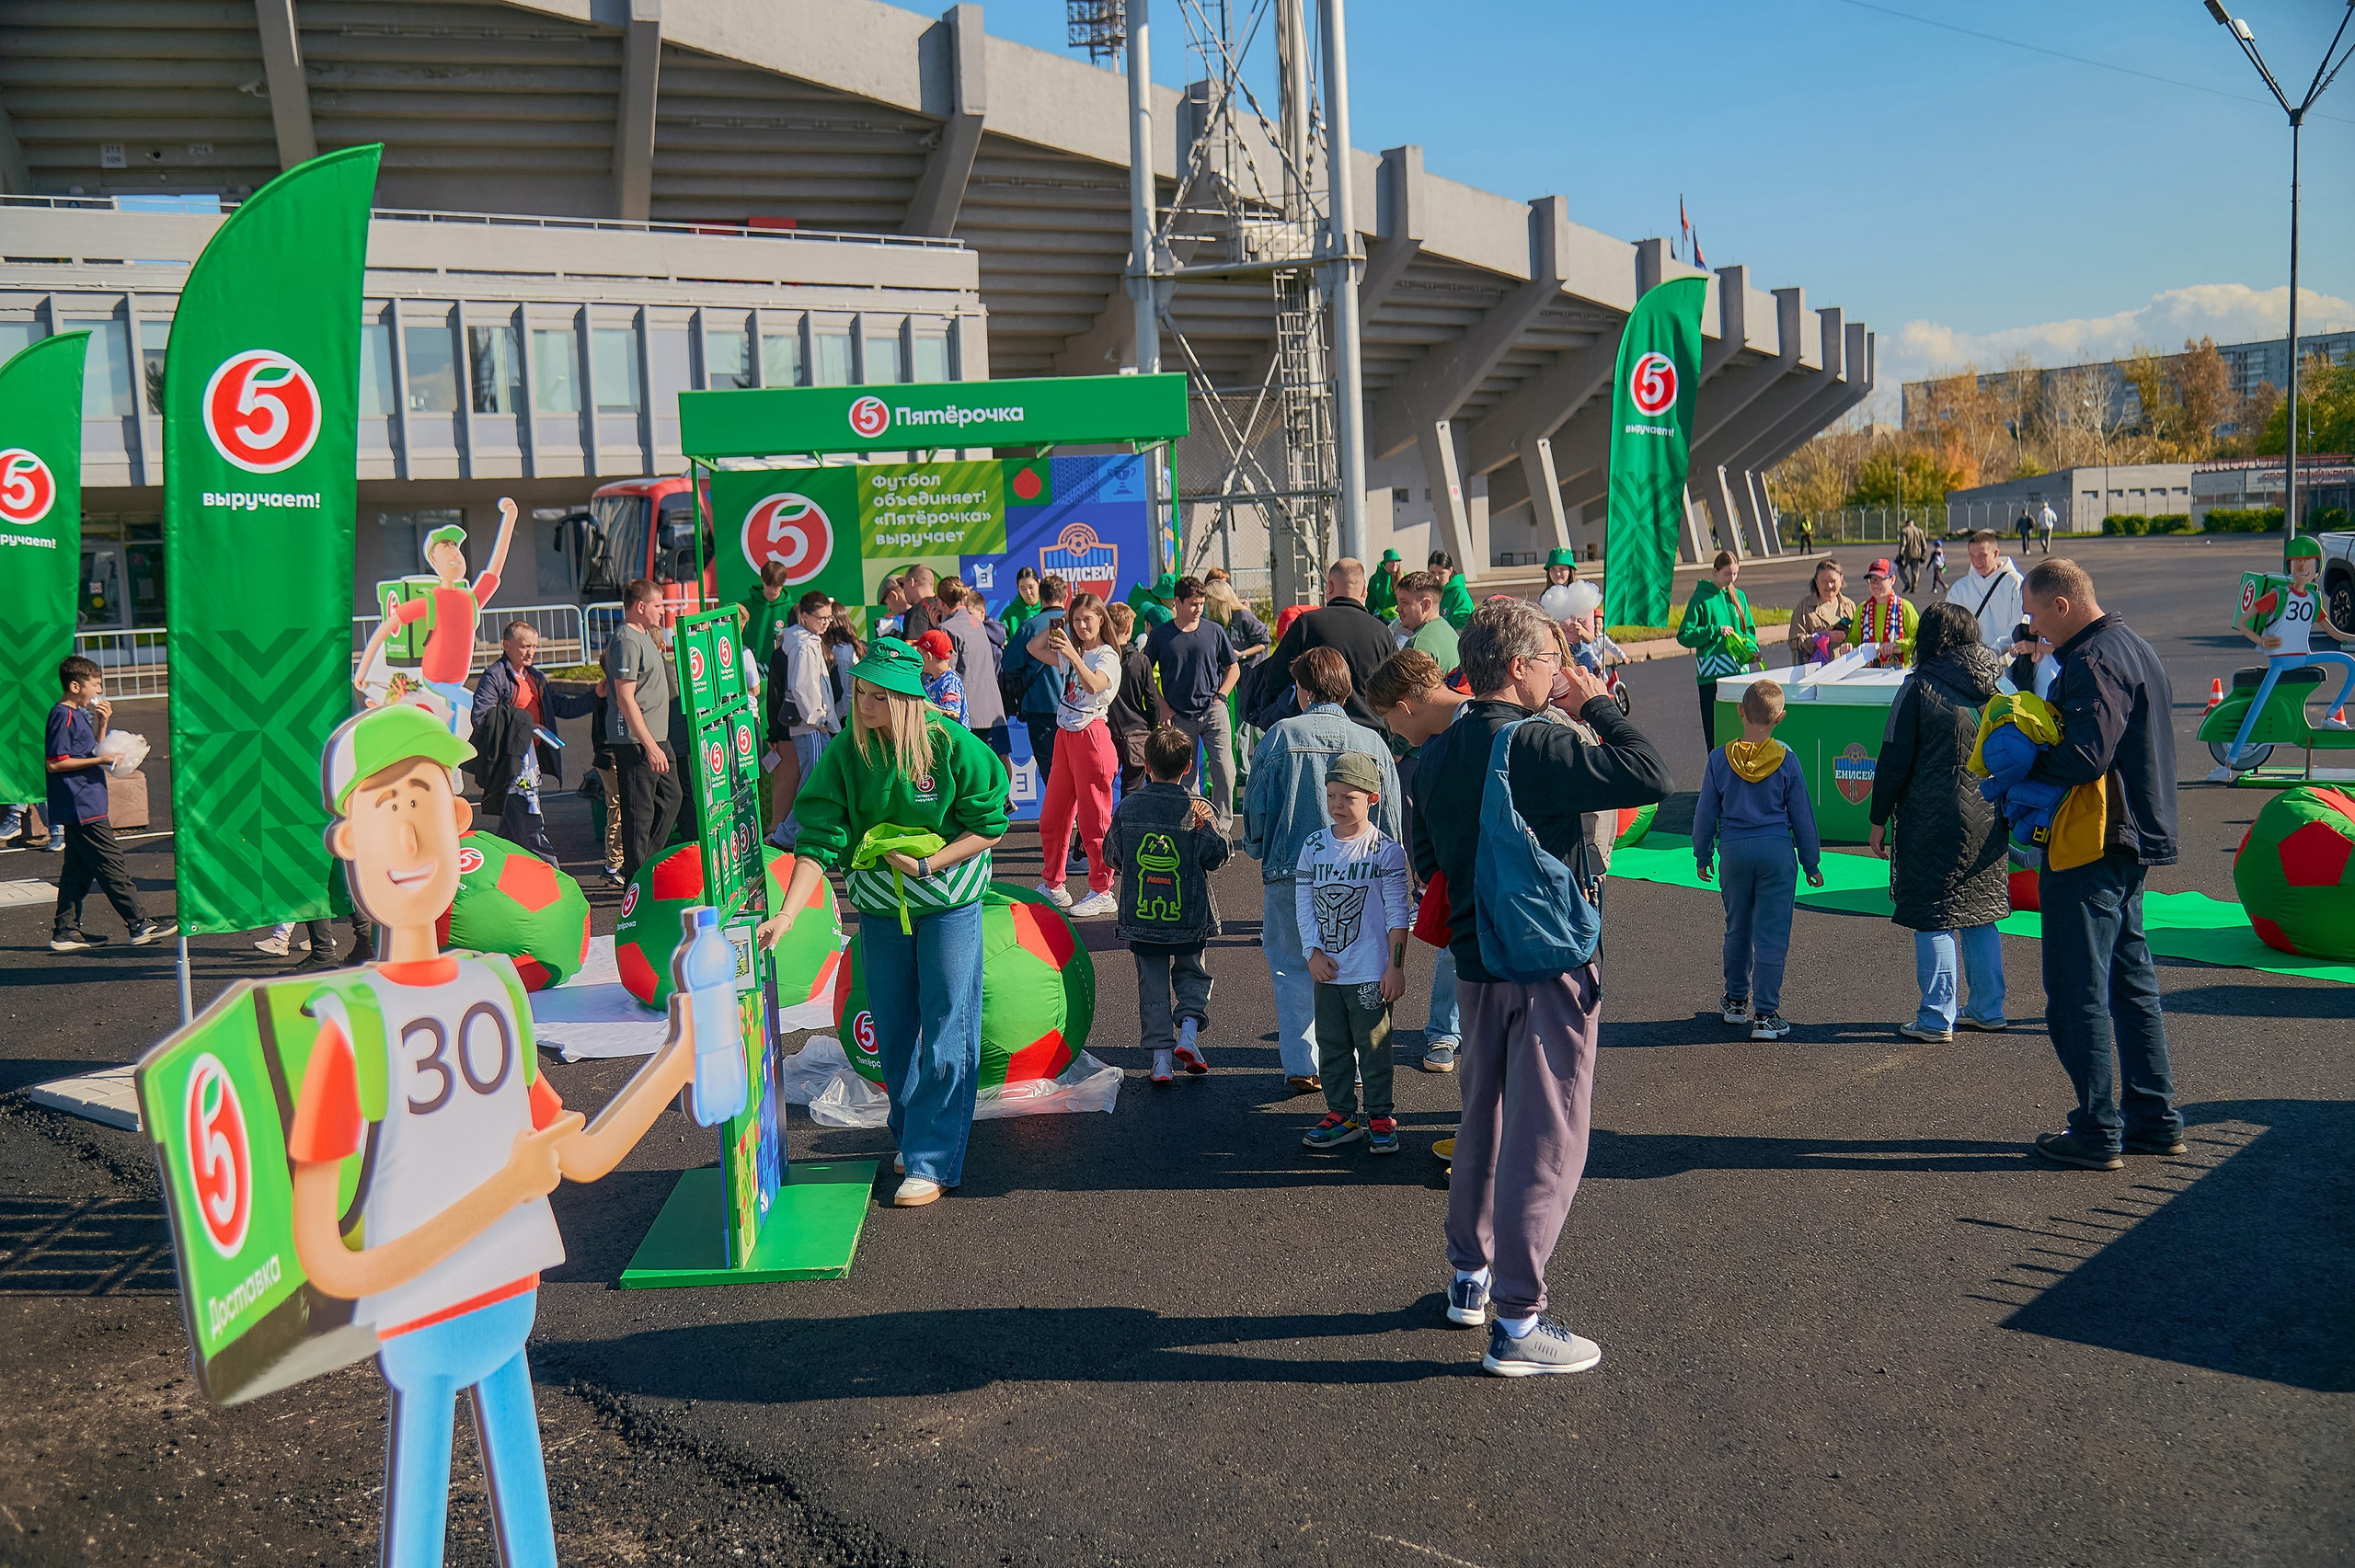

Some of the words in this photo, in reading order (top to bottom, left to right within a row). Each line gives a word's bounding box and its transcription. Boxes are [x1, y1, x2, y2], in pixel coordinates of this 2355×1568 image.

[895, 405, 1025, 429] Пятёрочка
[1625, 423, 1674, 438] выручает!
[872, 473, 941, 491] Футбол
[202, 491, 321, 511] выручает!
[874, 490, 988, 508] объединяет!
[874, 510, 992, 528] «Пятёрочка»
[0, 533, 56, 549] ручает!
[876, 529, 966, 548] выручает
[2285, 601, 2314, 622] 30
[1835, 769, 1875, 781] ЕНИСЕЙ
[399, 1001, 514, 1116] 30
[856, 1055, 882, 1070] Пятёро
[207, 1253, 281, 1342] Доставка
